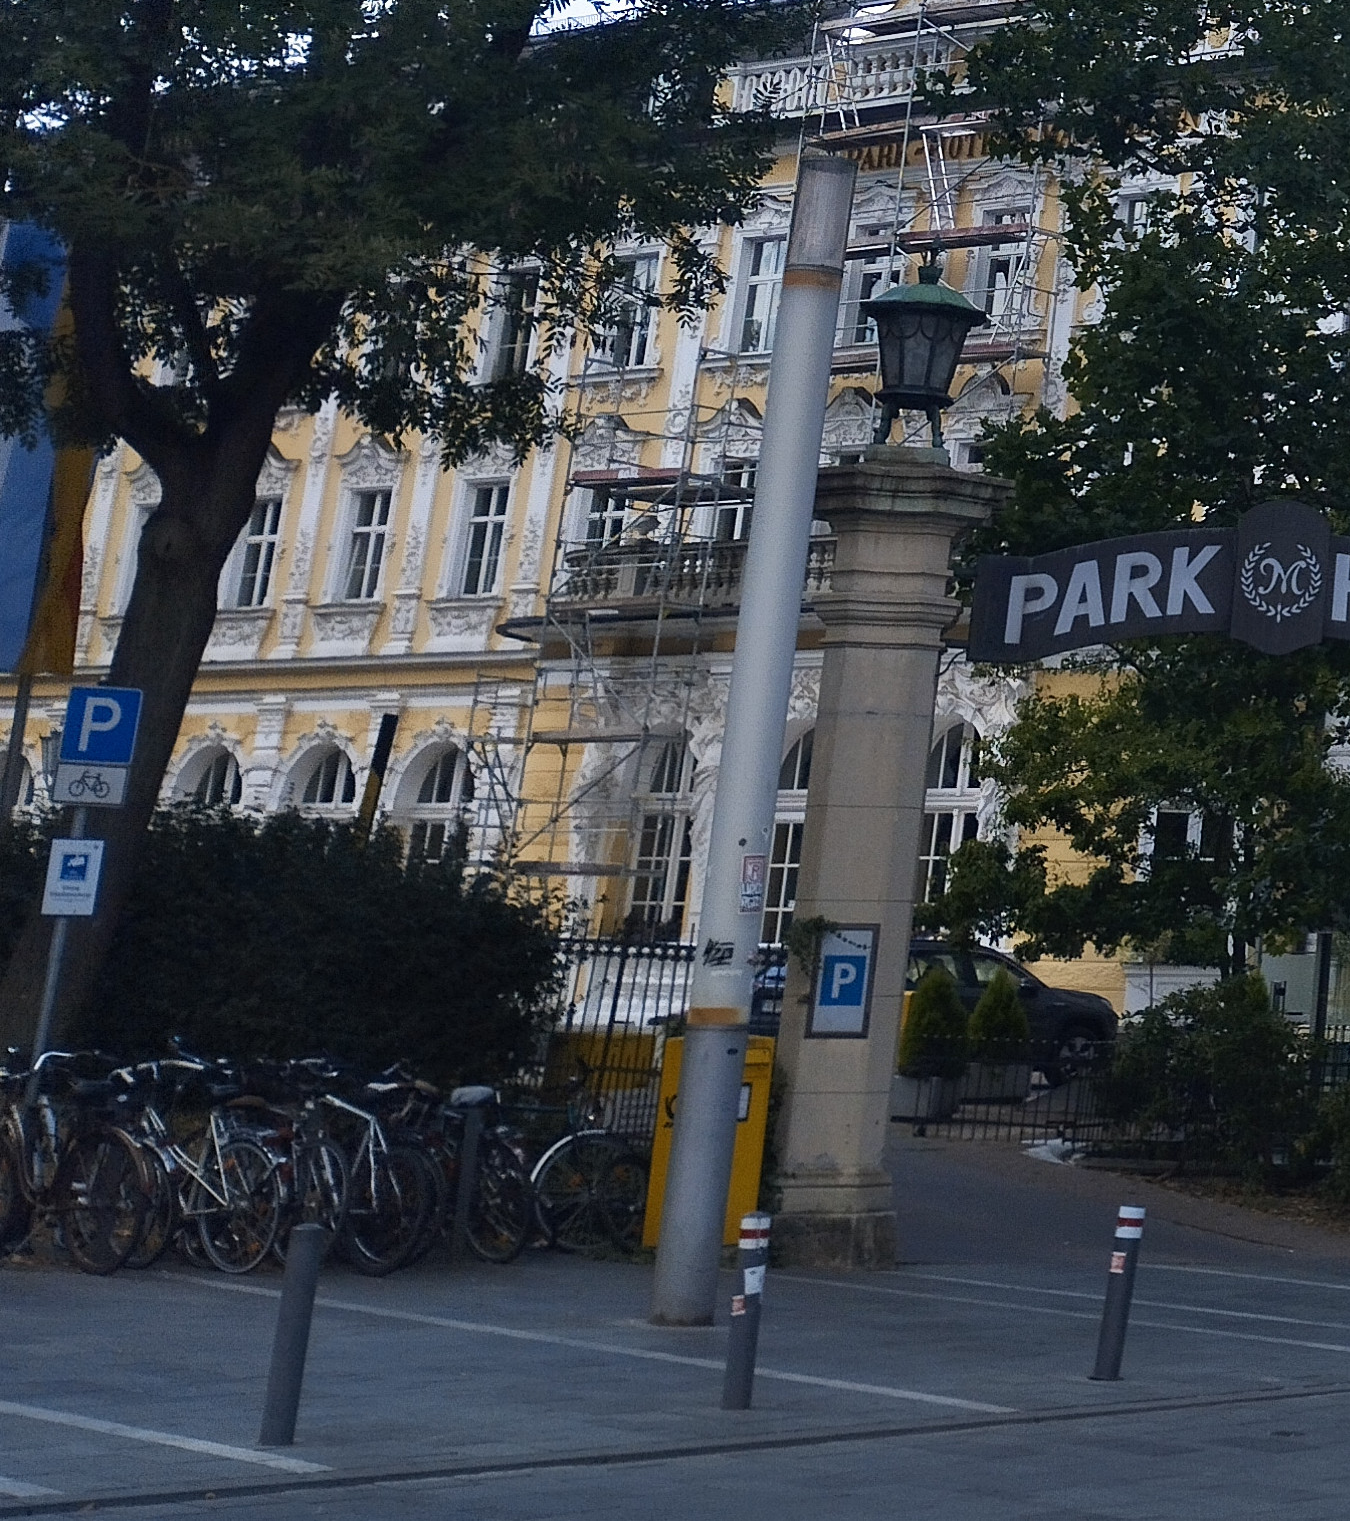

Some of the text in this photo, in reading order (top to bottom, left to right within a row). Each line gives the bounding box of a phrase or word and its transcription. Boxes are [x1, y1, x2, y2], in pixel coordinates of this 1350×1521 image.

[1003, 545, 1222, 644] PARK
[78, 697, 122, 752] P
[831, 962, 857, 999] P
